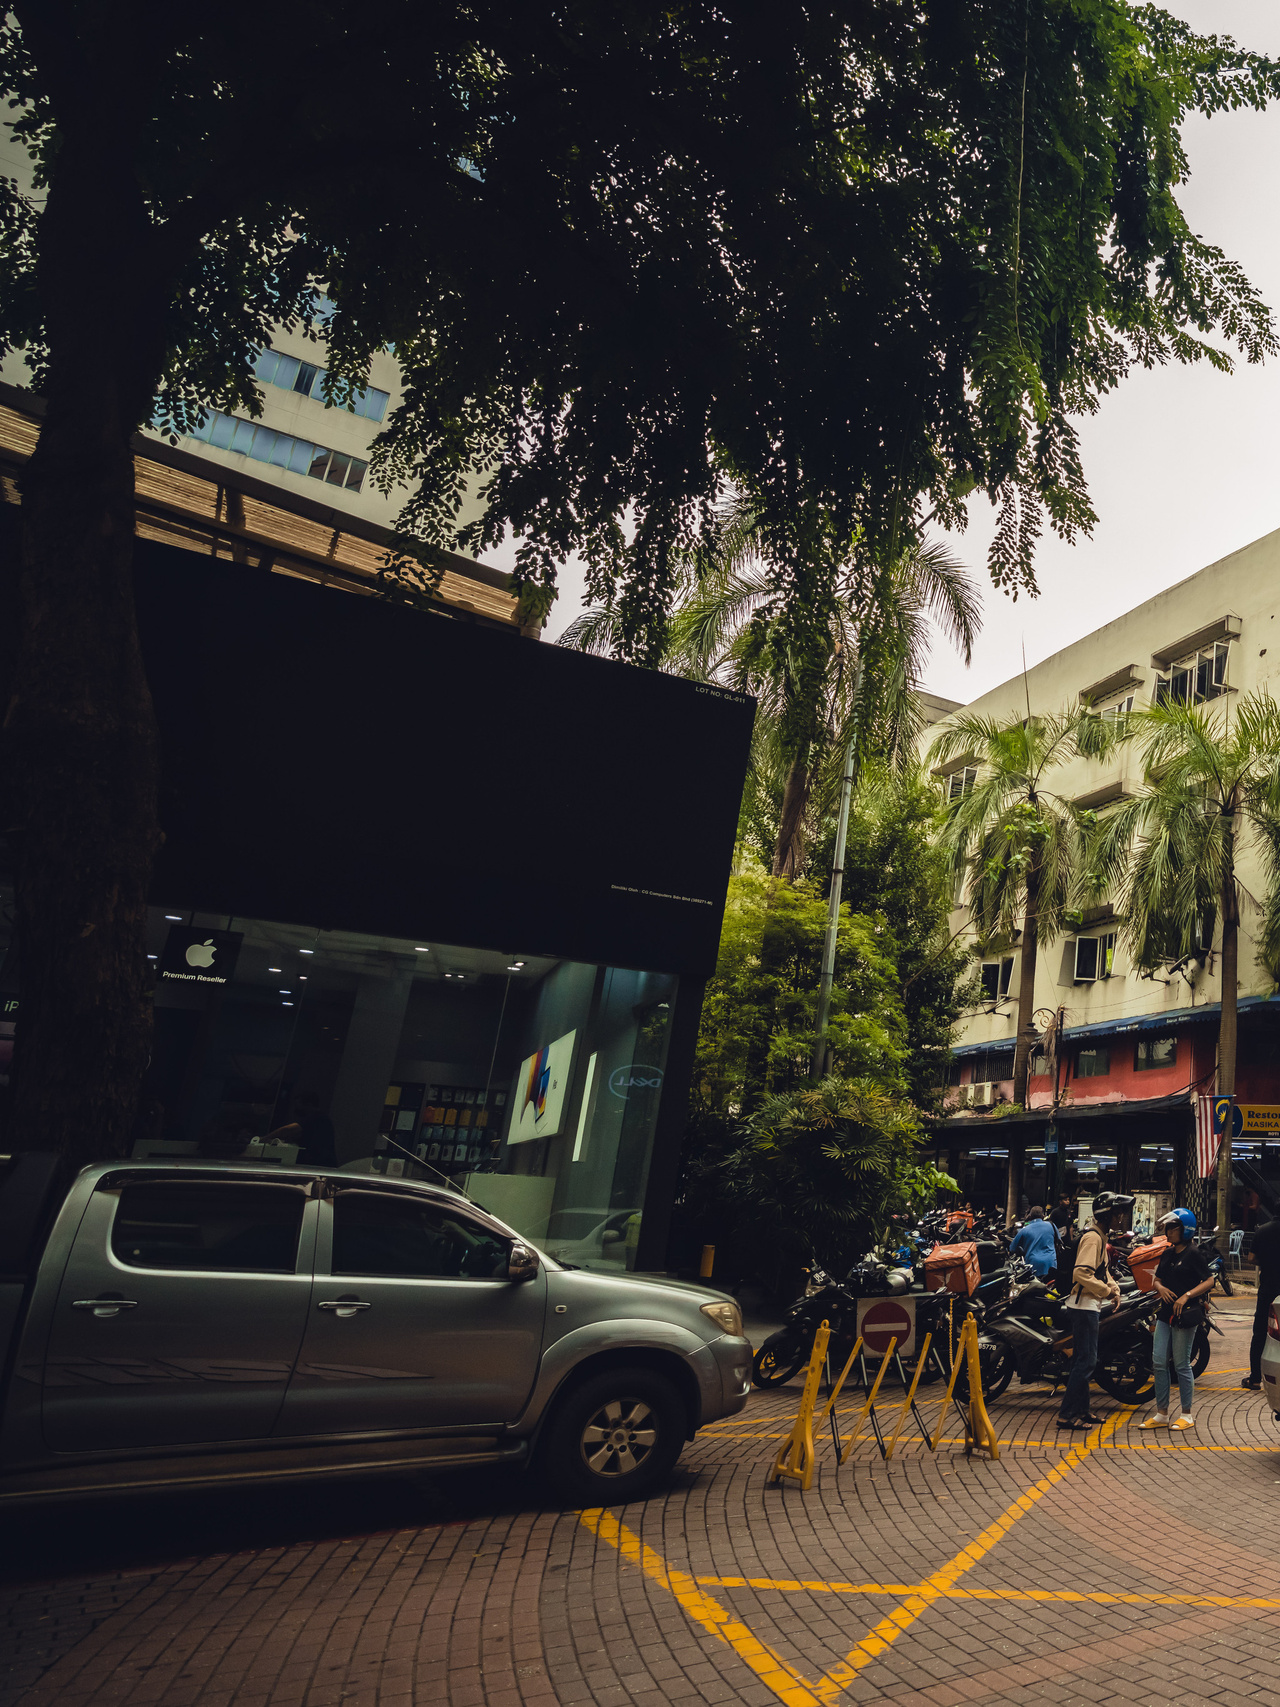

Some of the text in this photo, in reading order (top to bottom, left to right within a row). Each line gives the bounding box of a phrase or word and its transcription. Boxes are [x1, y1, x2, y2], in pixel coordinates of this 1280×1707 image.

[695, 686, 709, 694] LOT
[724, 694, 746, 704] GL-011
[162, 971, 227, 984] Premium Reseller
